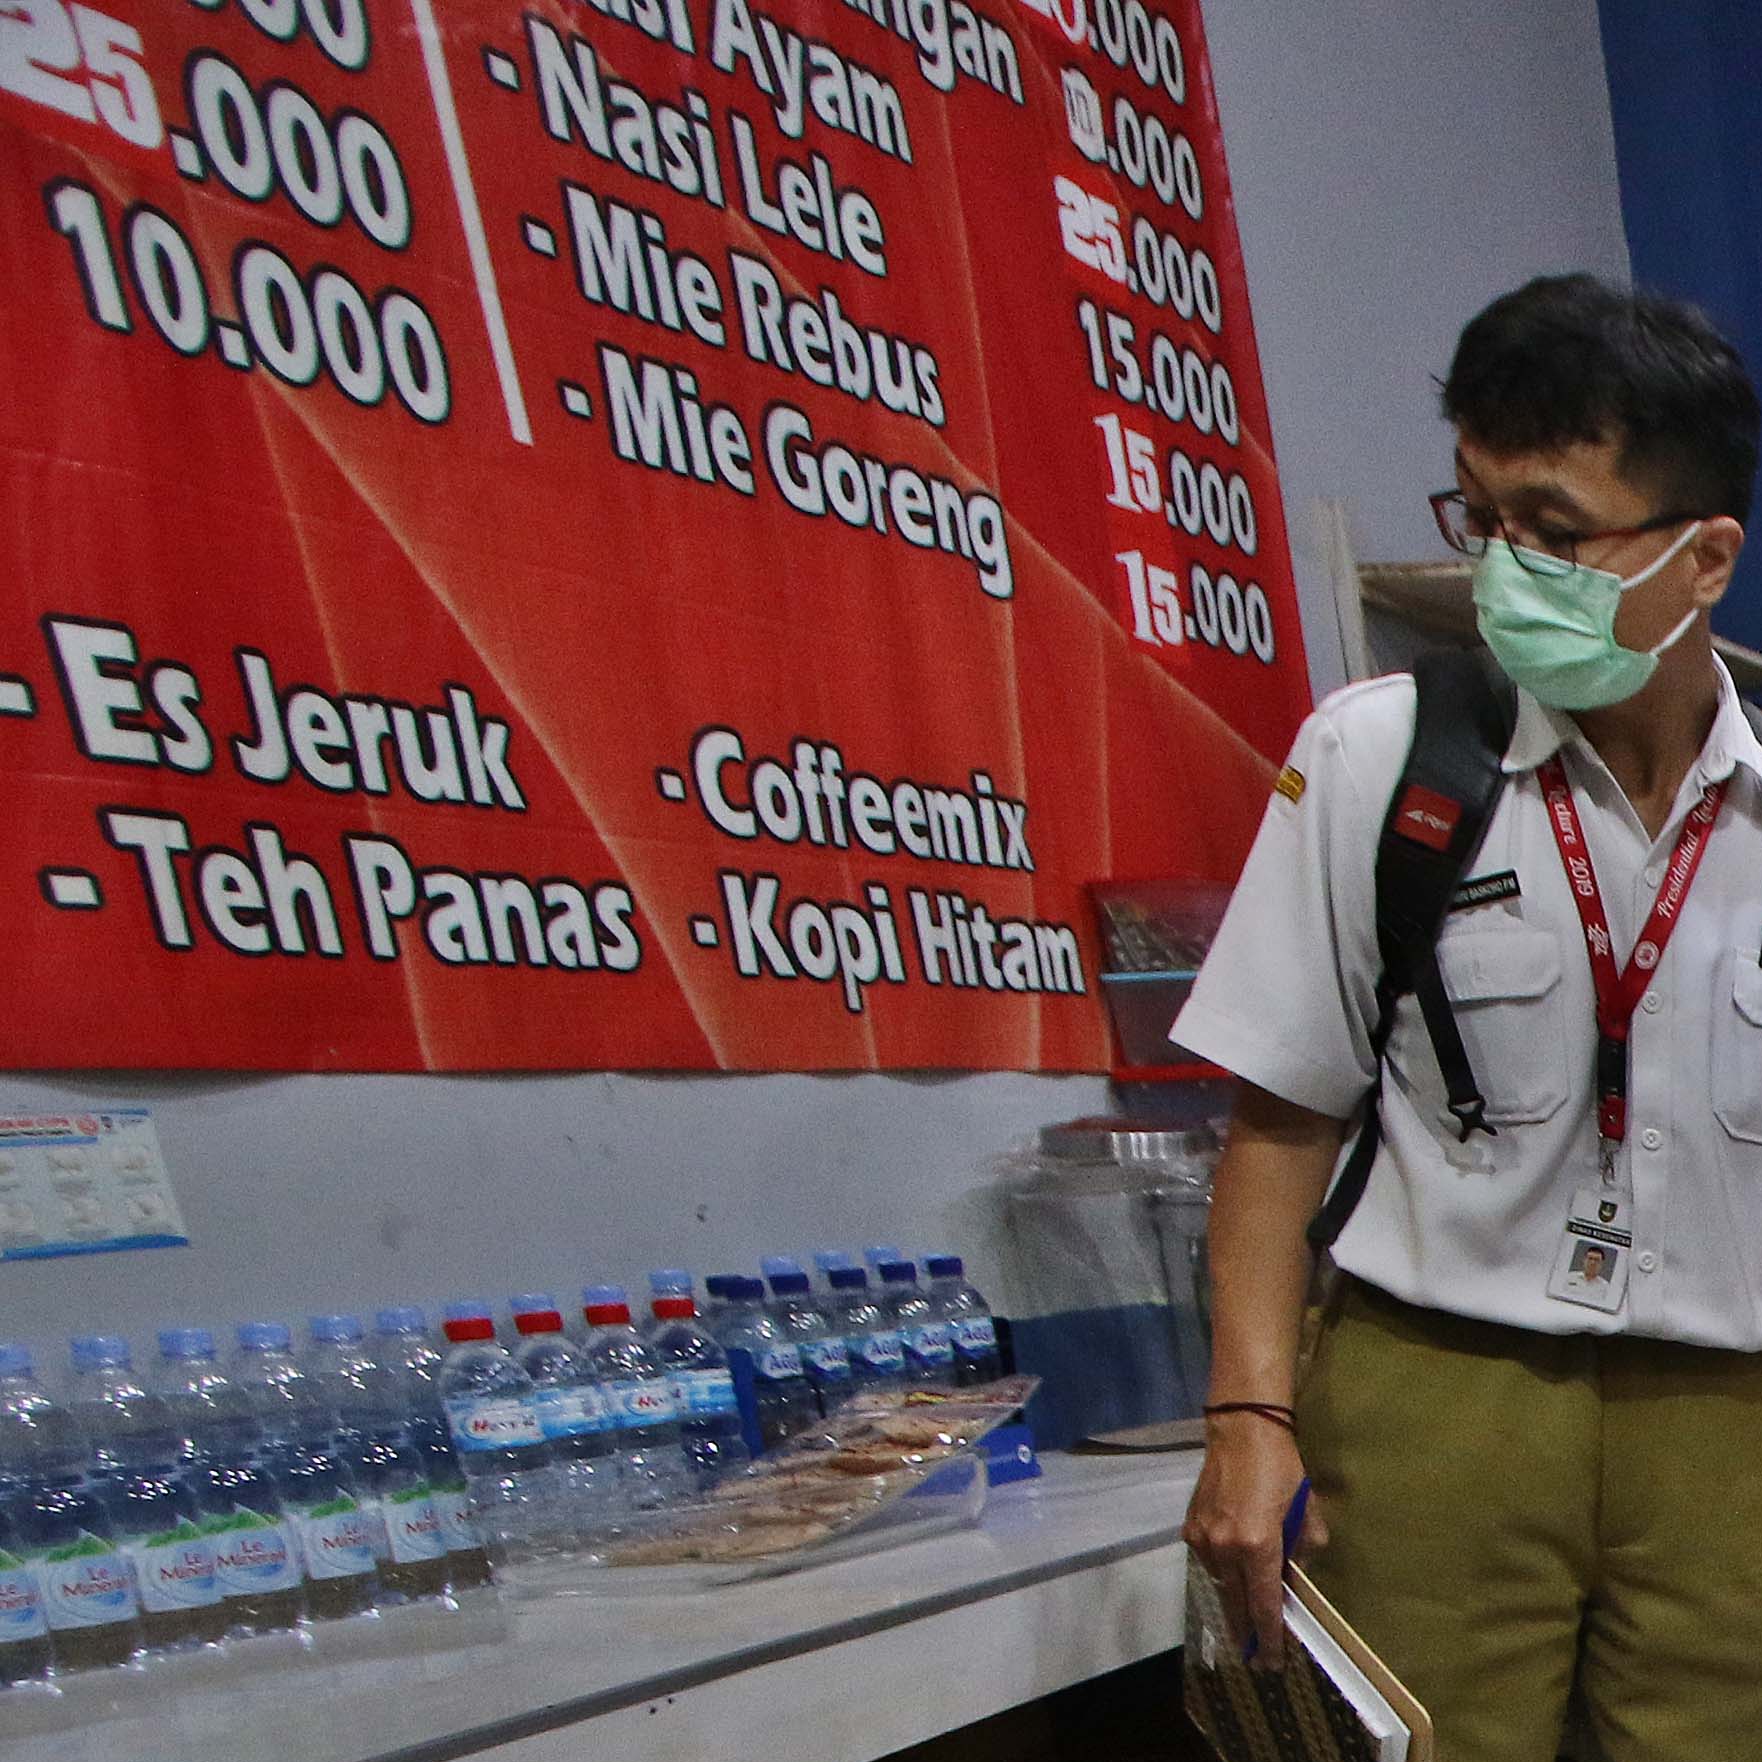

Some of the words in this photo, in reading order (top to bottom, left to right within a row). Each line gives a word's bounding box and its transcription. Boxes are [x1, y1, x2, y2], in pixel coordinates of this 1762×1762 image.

[527, 14, 726, 208] Nasi
[732, 116, 888, 276] Lele
[47, 180, 453, 425] 10.000
[563, 183, 724, 346] Mie
[731, 253, 945, 427] Rebus
[1054, 174, 1222, 335] 25.000
[1078, 299, 1240, 447] 15.000
[598, 345, 755, 496] Mie
[764, 404, 1013, 598] Goreng
[1094, 413, 1258, 556] 15.000
[1115, 549, 1276, 665] 15.000
[46, 616, 212, 772] Es
[231, 649, 527, 810] Jeruk
[693, 729, 1035, 873] Coffeemix
[1568, 856, 1594, 896] 2019
[1657, 830, 1700, 918] Presidential
[104, 810, 344, 956] Teh
[345, 833, 641, 973] Panas
[718, 873, 905, 1012] Kopi
[911, 888, 1086, 995] Hitam
